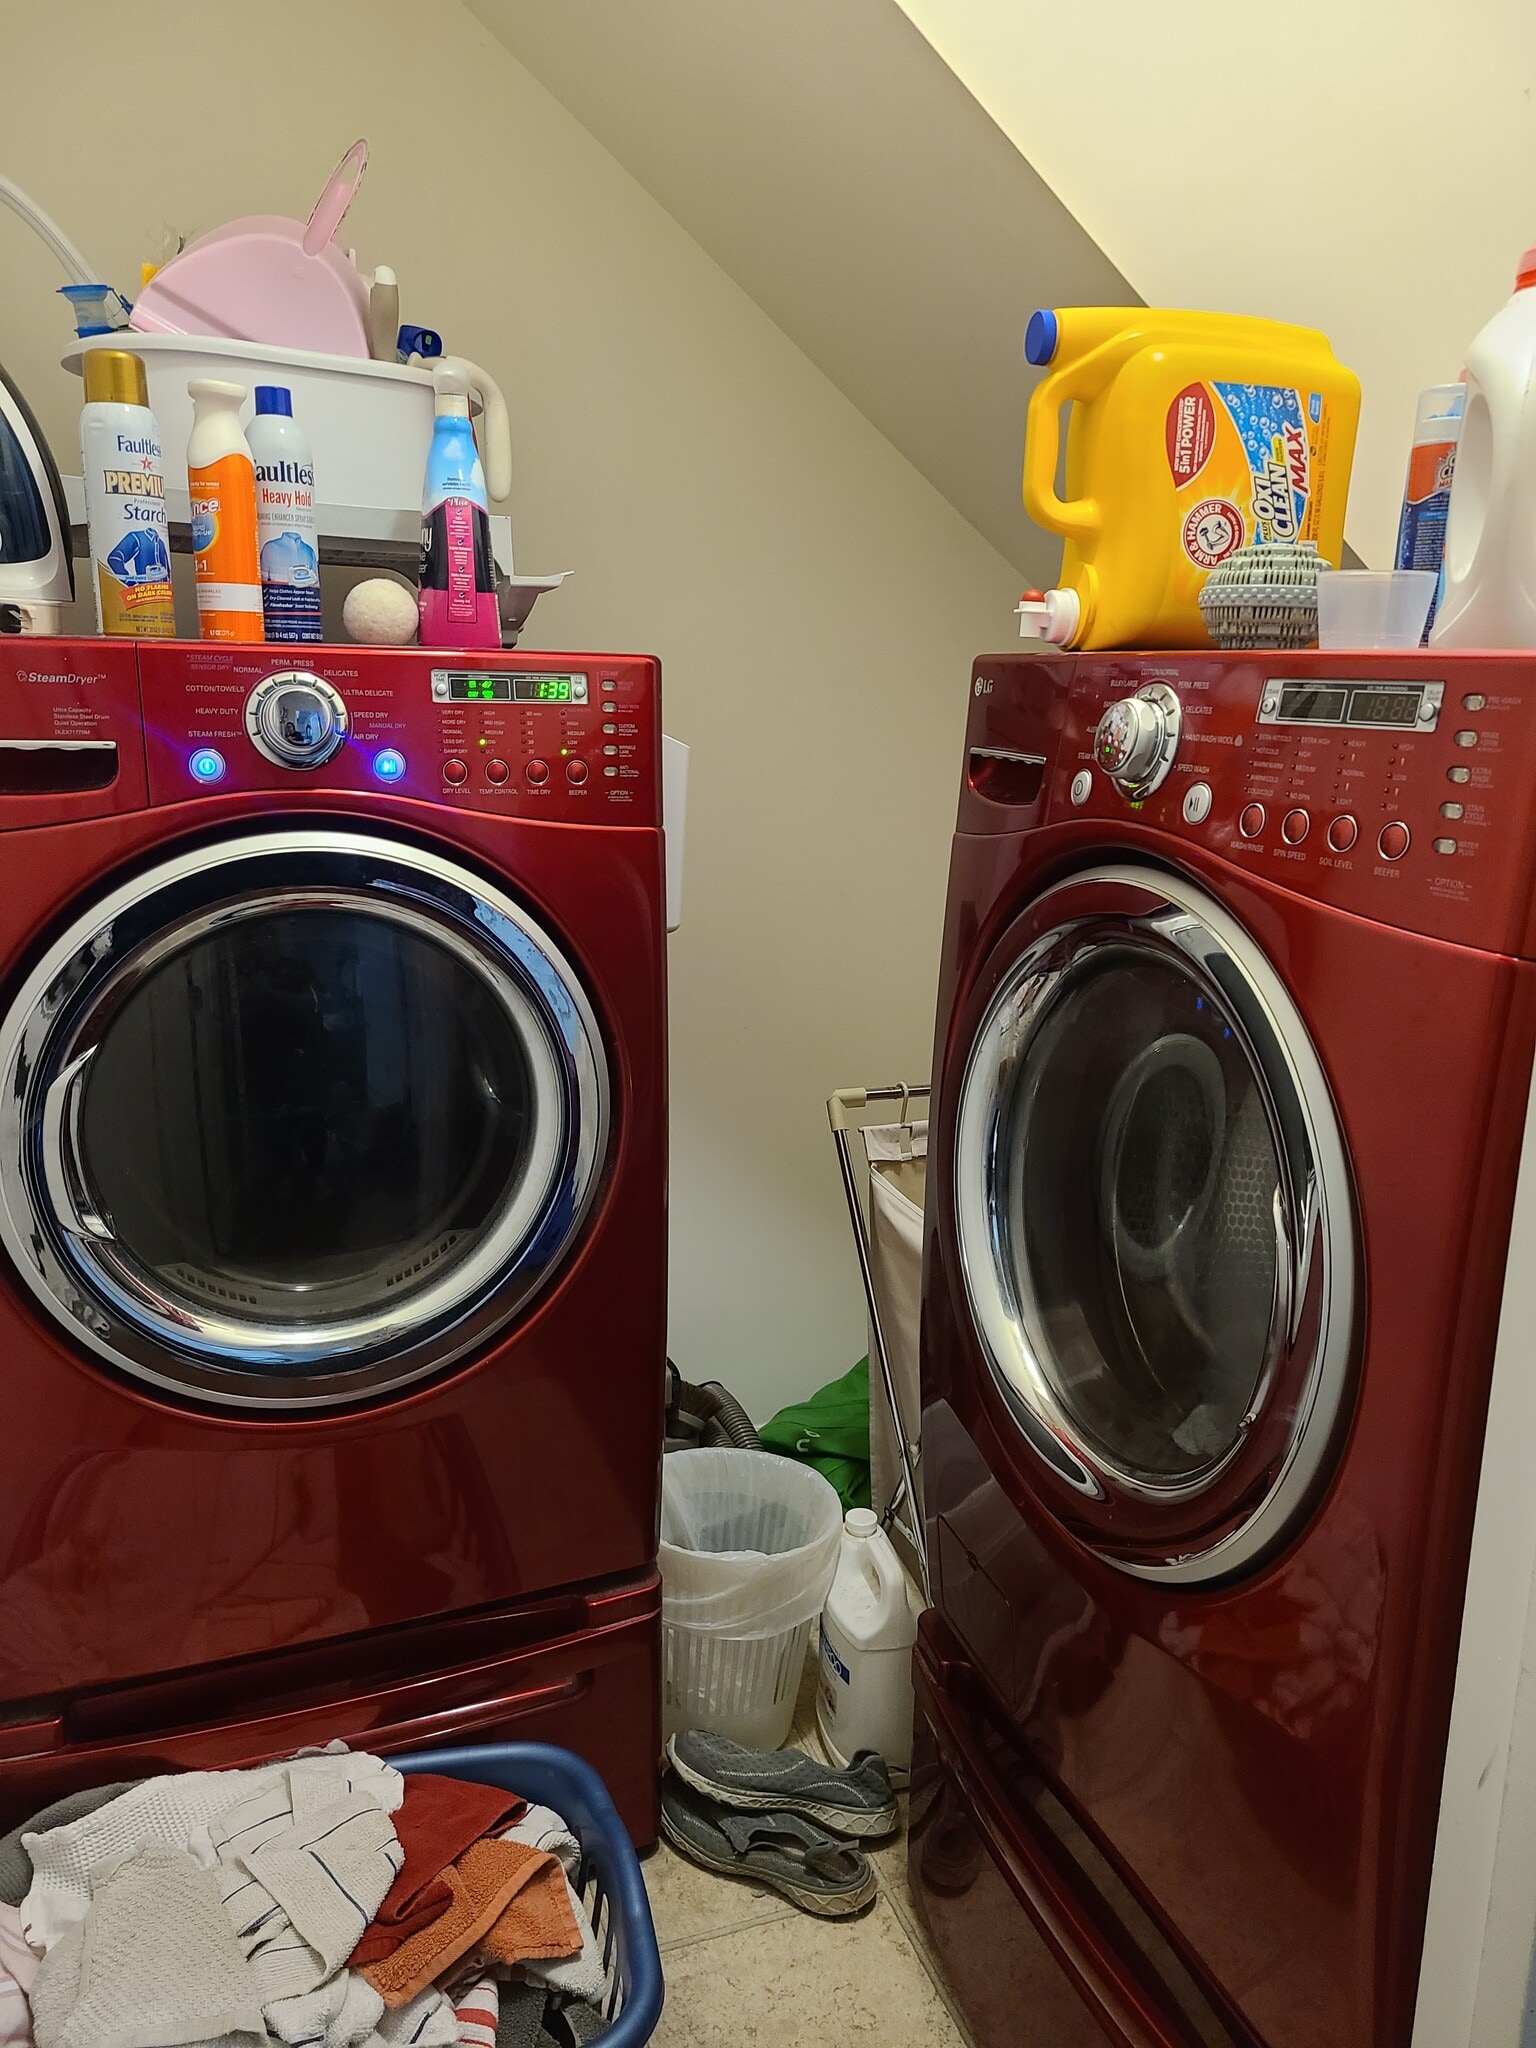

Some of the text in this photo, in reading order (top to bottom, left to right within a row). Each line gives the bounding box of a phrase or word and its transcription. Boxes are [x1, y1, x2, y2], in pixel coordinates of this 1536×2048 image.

[1181, 396, 1196, 448] POWER
[1285, 426, 1308, 494] MAX
[254, 459, 315, 488] aultles
[104, 471, 165, 500] PREMIU
[262, 487, 312, 508] Heavy Hold
[1253, 476, 1275, 521] OXI
[1268, 462, 1294, 537] CLEAN
[123, 503, 167, 524] Starch
[1187, 504, 1222, 566] ARM & HAMMER
[135, 584, 145, 593] NO
[126, 592, 137, 601] ON
[138, 590, 156, 599] DARK
[271, 658, 291, 666] PERM.
[233, 666, 263, 674] NORMAL
[323, 669, 359, 677] DELICATES
[185, 684, 245, 693] COTTON/TOWELS
[540, 681, 569, 699] 1:39
[983, 679, 994, 694] LG
[1178, 680, 1210, 690] PERM. PRESS
[1185, 705, 1213, 714] DELICATES
[353, 711, 389, 719] SPEED DRY
[188, 730, 212, 738] STEAM
[1185, 734, 1201, 742] HAND
[1177, 764, 1193, 772] SPEED
[1295, 764, 1317, 772] MEDIUM
[1342, 769, 1365, 777] NORMAL
[1292, 778, 1305, 786] LOW
[1289, 791, 1311, 801] NO SPIN
[1386, 803, 1399, 811] OFF
[1463, 811, 1485, 820] CYCLE
[1272, 848, 1307, 862] SPIN SPEED
[1318, 856, 1354, 871] SOIL LEVEL
[1373, 866, 1400, 879] BEEPER
[1434, 877, 1465, 889] OPTION
